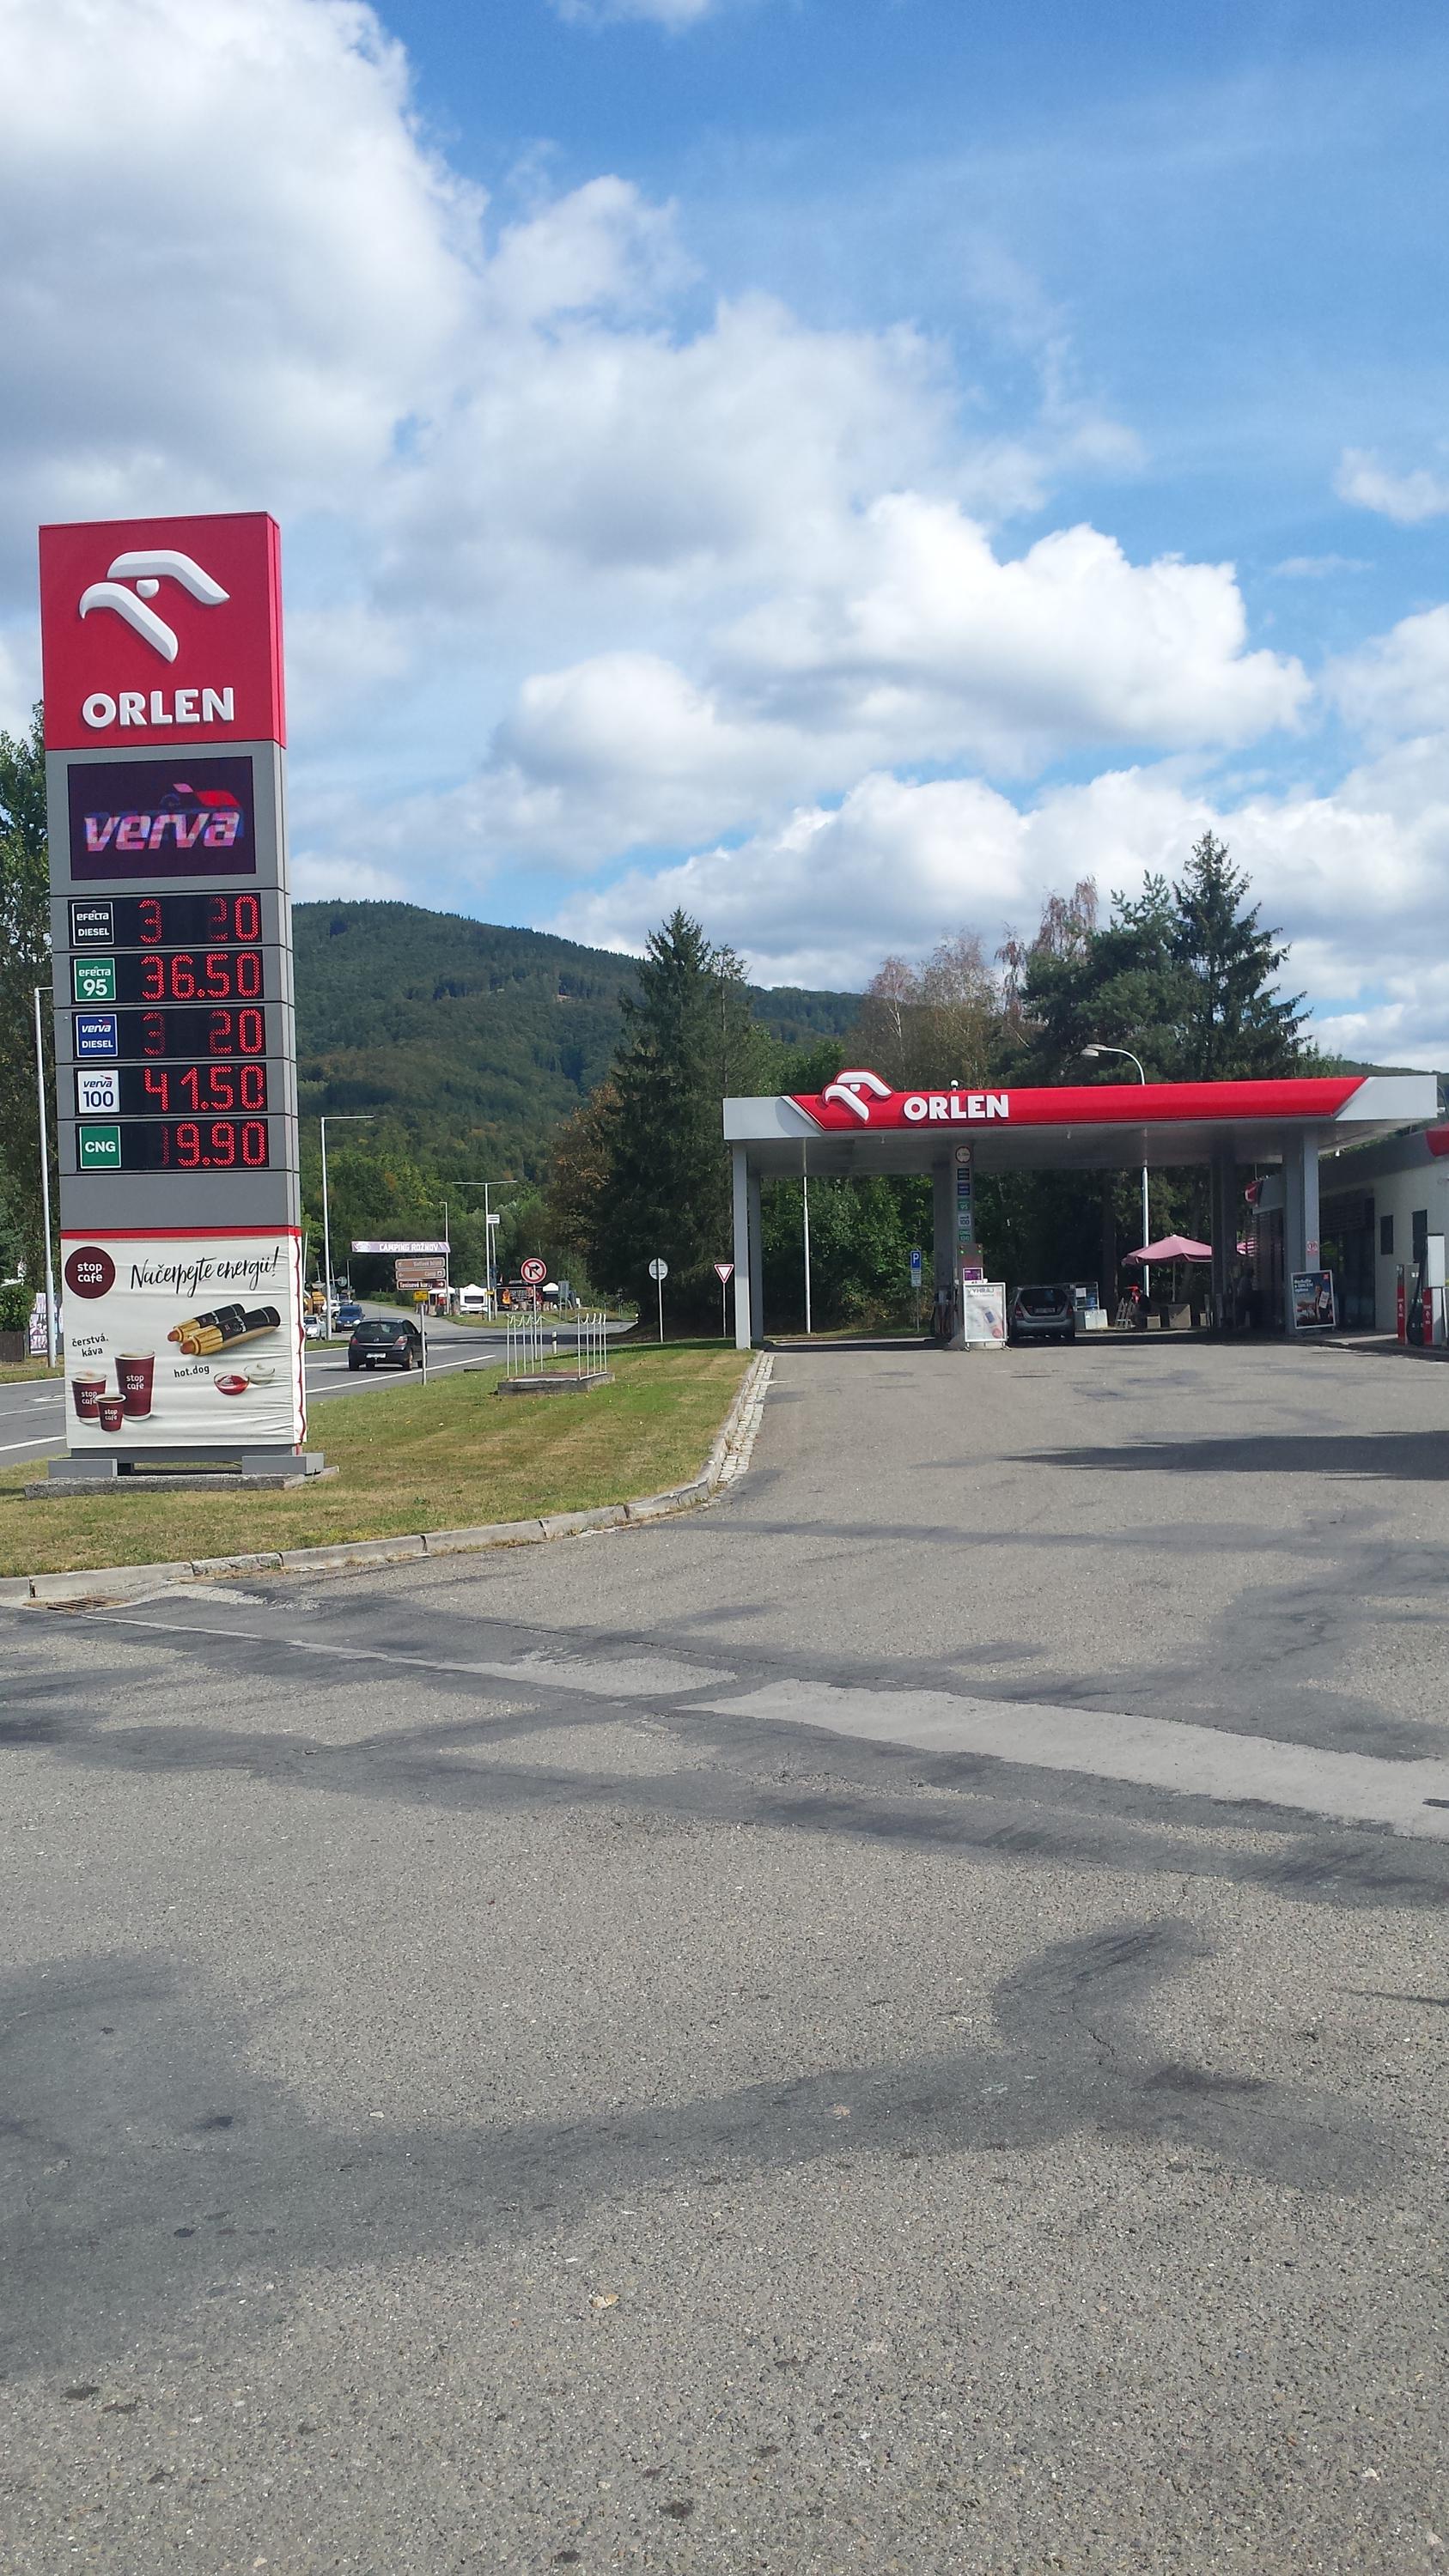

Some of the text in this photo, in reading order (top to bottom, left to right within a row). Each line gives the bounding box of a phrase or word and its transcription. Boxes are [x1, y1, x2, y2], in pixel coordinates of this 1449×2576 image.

[82, 687, 234, 728] ORLEN
[84, 810, 241, 853] verva
[78, 927, 110, 937] DIESEL
[141, 952, 260, 1000] 36.50
[83, 978, 108, 997] 95
[82, 1024, 112, 1033] verva
[82, 1039, 113, 1048] DIESEL
[83, 1078, 113, 1089] verva
[144, 1065, 265, 1112] 41.50
[82, 1091, 114, 1109] 100
[903, 1094, 1009, 1121] ORLEN
[84, 1140, 116, 1154] CNG
[379, 1242, 440, 1252] CAMPING ROŽNOV
[913, 1253, 919, 1264] P
[76, 1261, 103, 1274] stop
[131, 1246, 279, 1298] Načerpejte energii!
[76, 1272, 103, 1284] cafe
[82, 1346, 104, 1358] káva
[126, 1382, 145, 1391] cafe
[81, 1390, 98, 1399] stop
